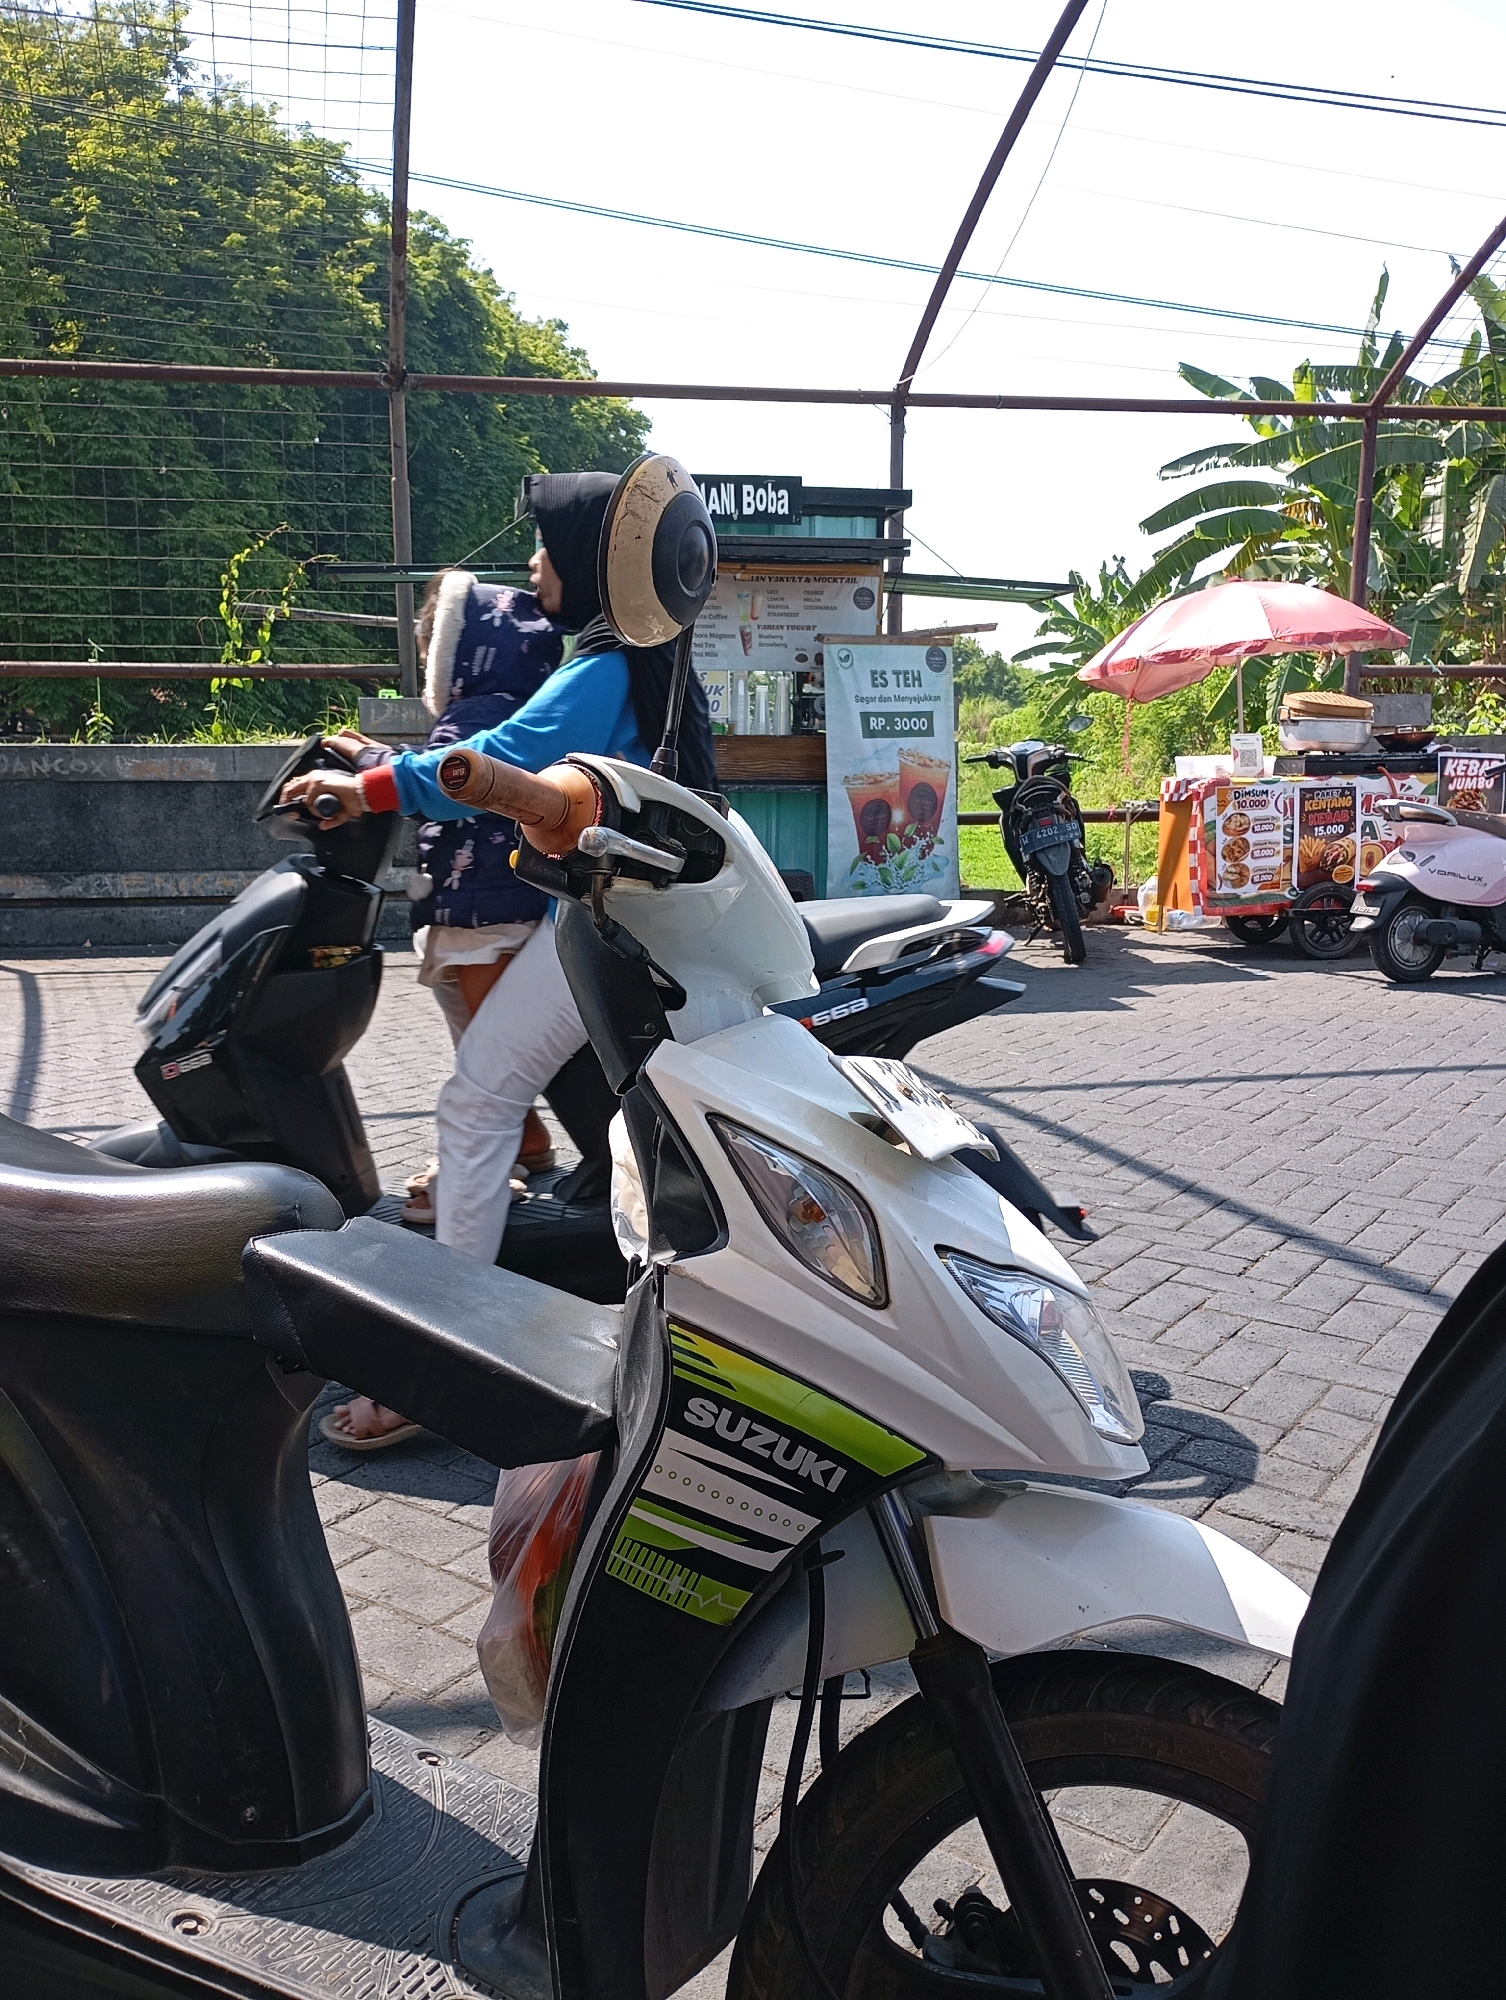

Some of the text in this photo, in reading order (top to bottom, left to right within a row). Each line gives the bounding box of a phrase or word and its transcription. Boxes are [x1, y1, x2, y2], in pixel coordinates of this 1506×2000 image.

[742, 482, 789, 515] Boba
[767, 575, 803, 584] YAKULT
[812, 576, 859, 585] MOCKTAIL
[869, 669, 923, 688] ES TEH
[854, 693, 942, 705] Segar dan Menyejukkan
[869, 716, 928, 731] RP. 3000
[1448, 776, 1495, 791] JUMBO
[1314, 789, 1341, 800] PAKET
[1236, 799, 1267, 809] 10.000
[1304, 796, 1353, 811] KENTANG
[1308, 810, 1350, 825] KEBAB
[1021, 822, 1078, 846] W 4202 SD
[1253, 824, 1274, 832] 10.000
[1314, 824, 1345, 836] 15.000
[1252, 849, 1274, 858] 10.000
[1252, 874, 1273, 883] 10.000
[683, 1397, 847, 1493] SUZUKI
